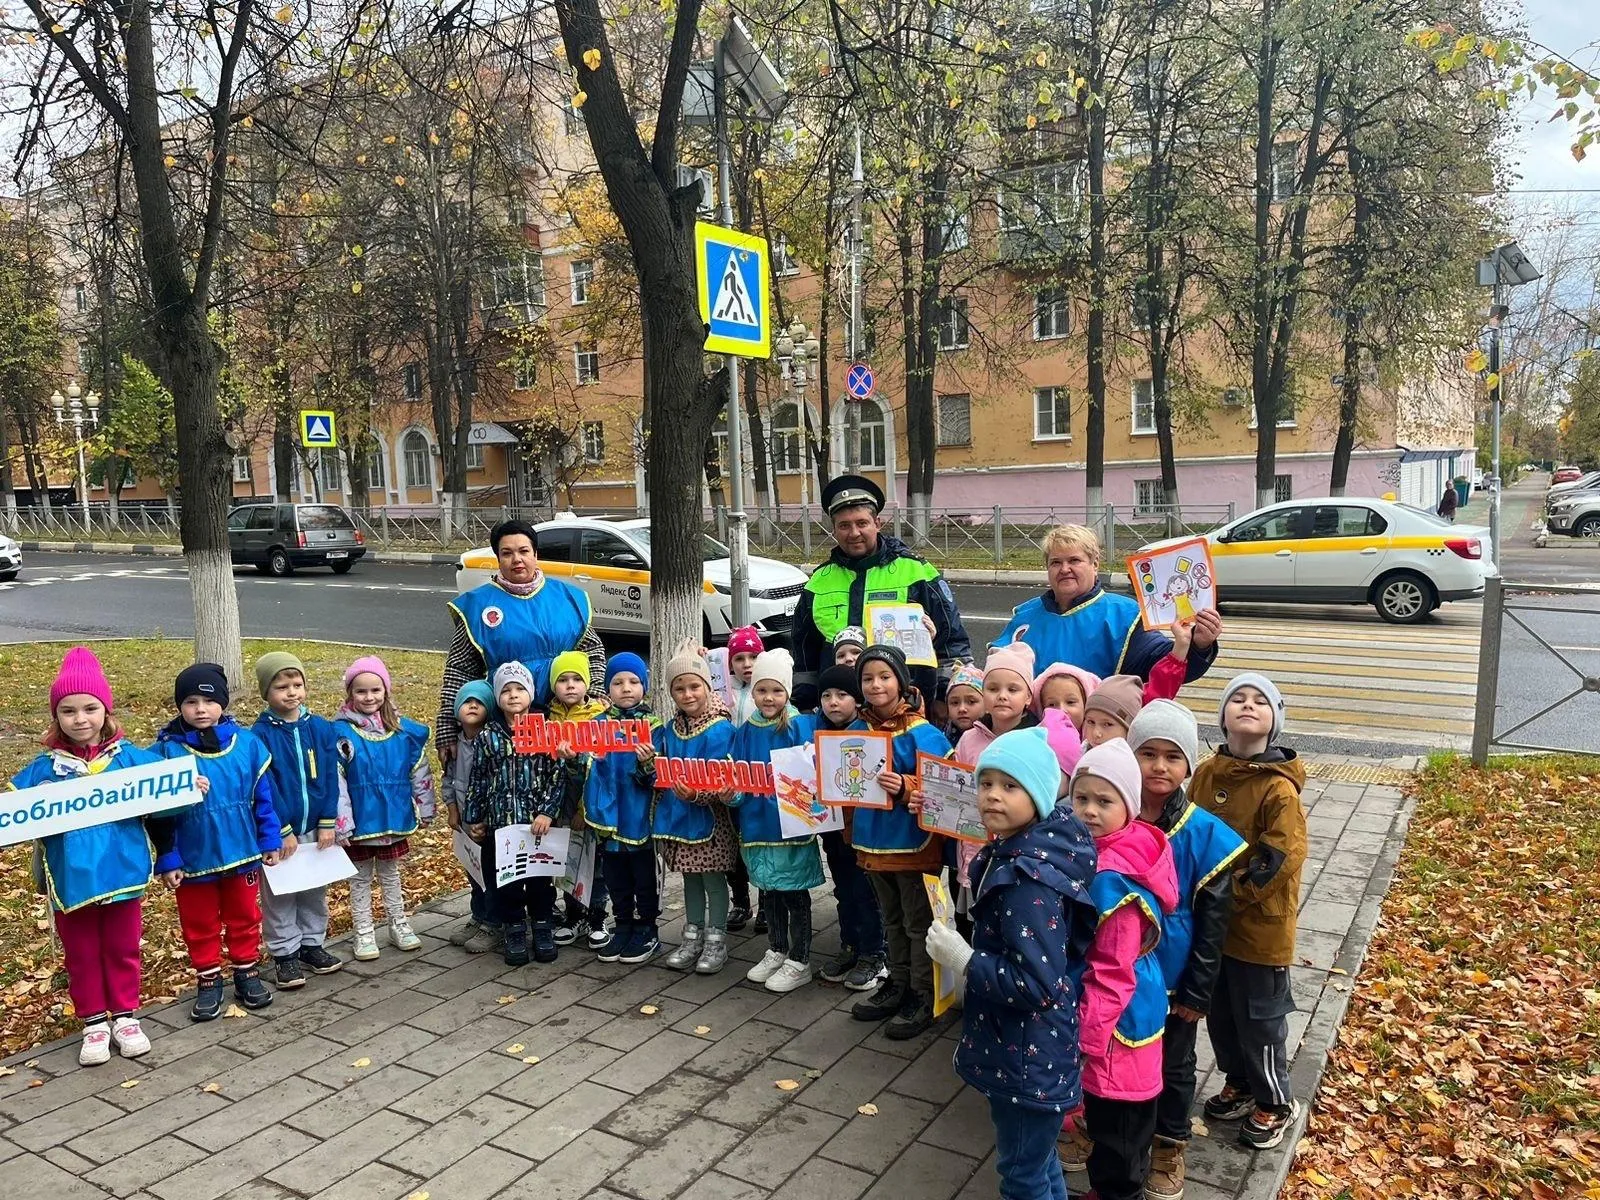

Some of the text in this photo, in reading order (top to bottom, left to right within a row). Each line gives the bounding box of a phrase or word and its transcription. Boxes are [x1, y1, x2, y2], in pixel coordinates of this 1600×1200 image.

[601, 584, 640, 599] Яндекс Go
[599, 608, 613, 616] (495)
[620, 599, 641, 610] Такси
[512, 713, 653, 760] #Пропусти
[0, 769, 194, 829] соблюдайПДД
